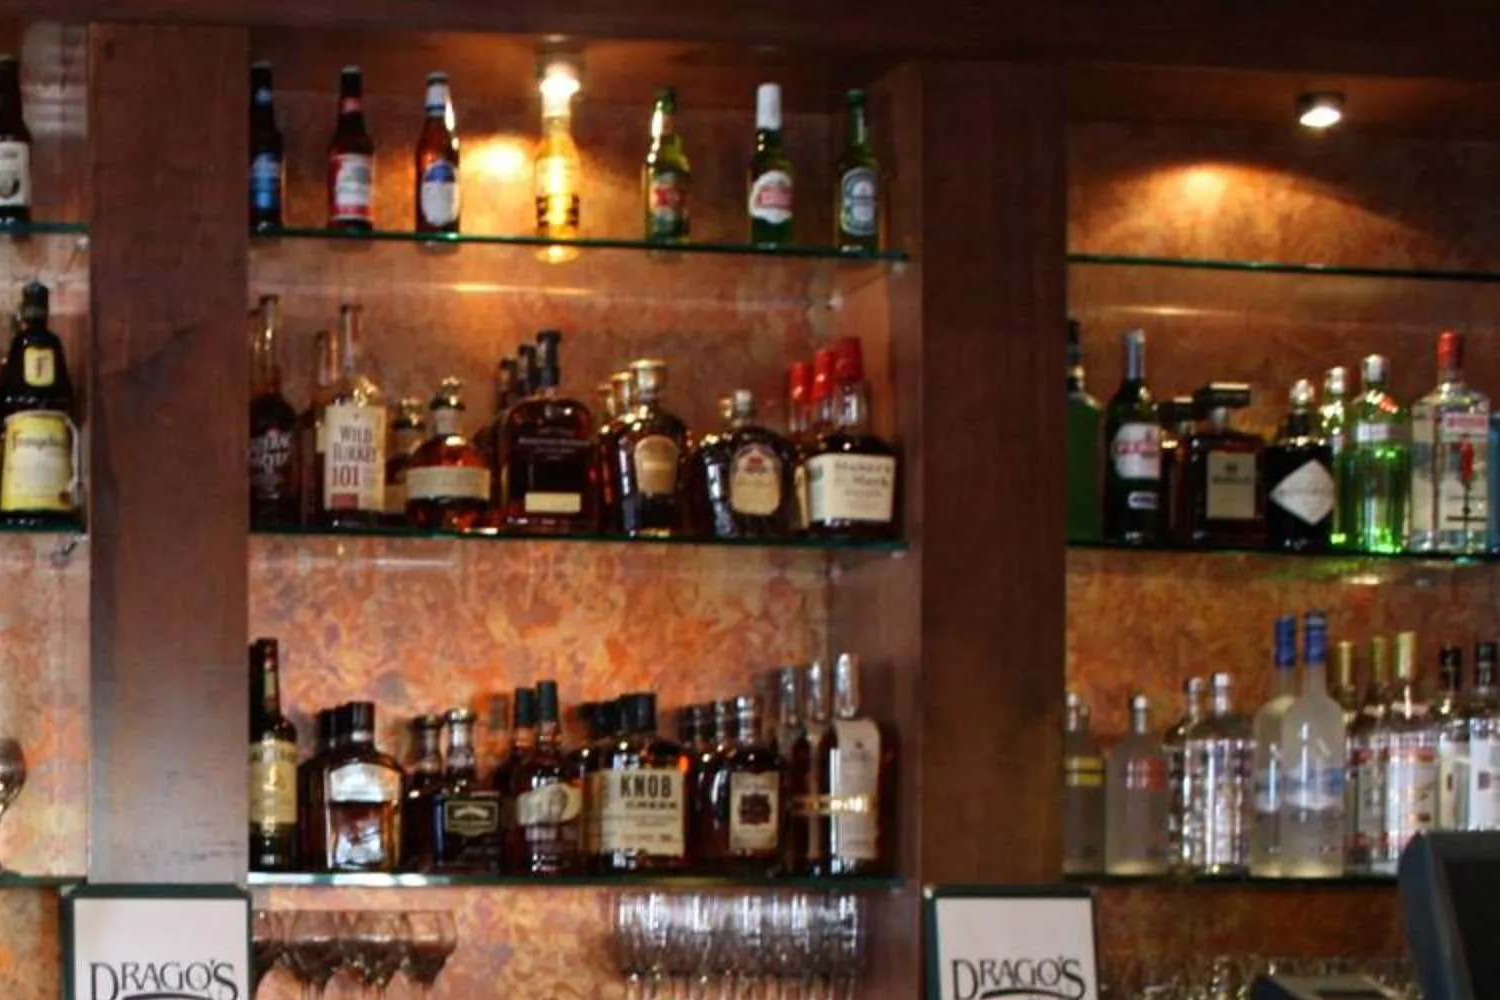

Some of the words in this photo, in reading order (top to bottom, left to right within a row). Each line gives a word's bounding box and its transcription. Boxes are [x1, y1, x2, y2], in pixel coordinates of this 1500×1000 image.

[340, 425, 372, 444] WILD
[333, 465, 359, 487] 101
[620, 774, 671, 798] KNOB
